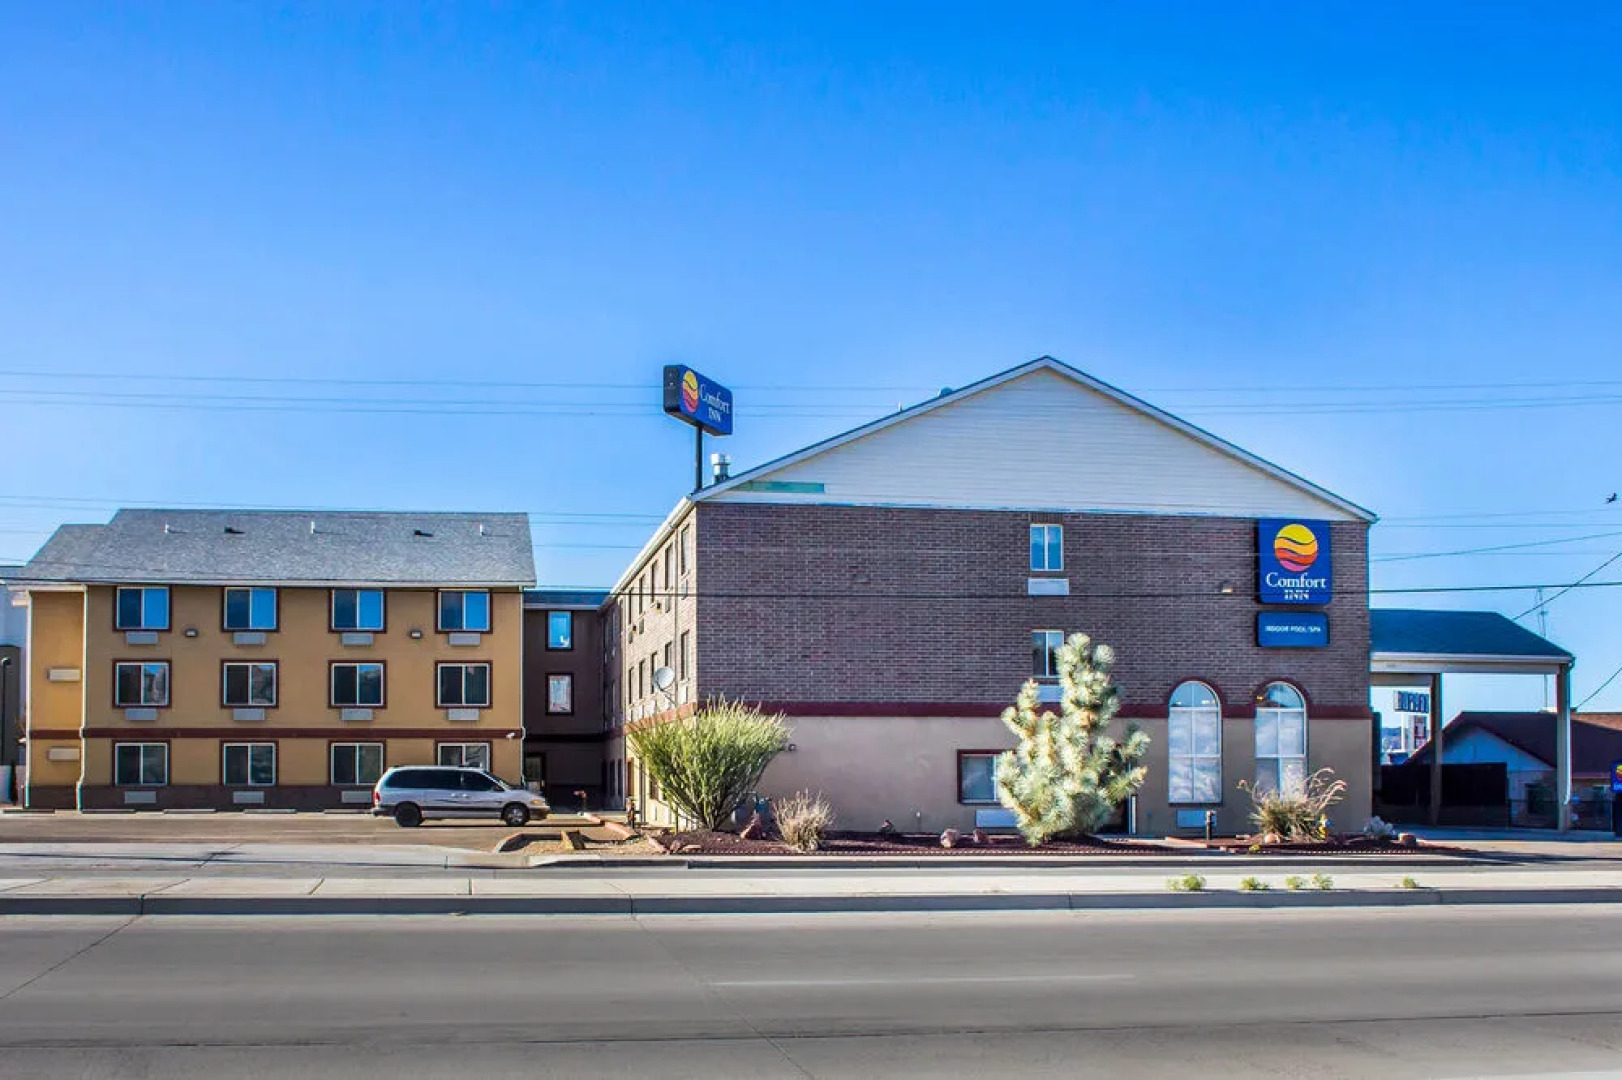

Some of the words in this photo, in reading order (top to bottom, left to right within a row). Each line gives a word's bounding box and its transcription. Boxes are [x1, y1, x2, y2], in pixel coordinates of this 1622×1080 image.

[700, 384, 729, 414] Comfort
[1265, 572, 1326, 588] Comfort
[1284, 589, 1310, 600] INN
[1264, 625, 1289, 633] INDOOR
